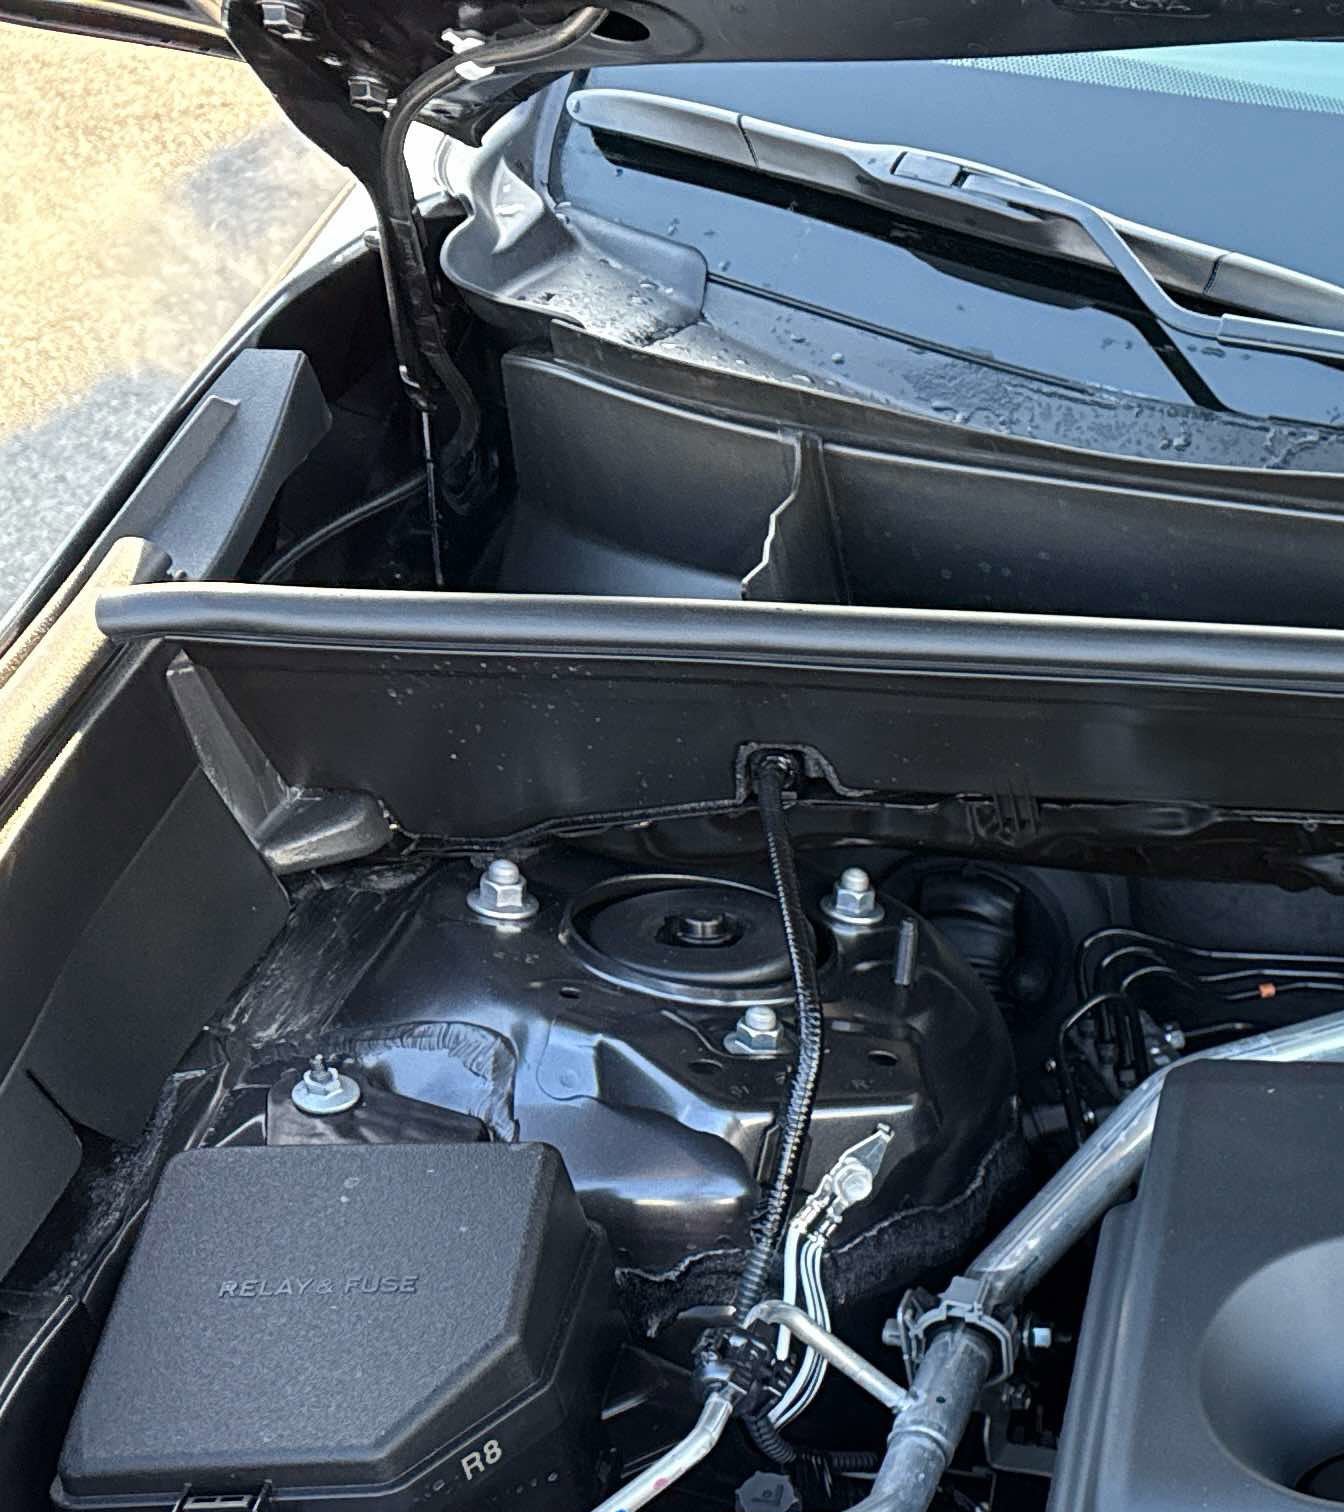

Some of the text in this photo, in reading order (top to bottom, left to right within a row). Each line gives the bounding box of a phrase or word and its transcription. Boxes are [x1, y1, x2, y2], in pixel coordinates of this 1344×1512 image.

[217, 1275, 420, 1299] RELAY & FUSE
[461, 1438, 503, 1481] R8
